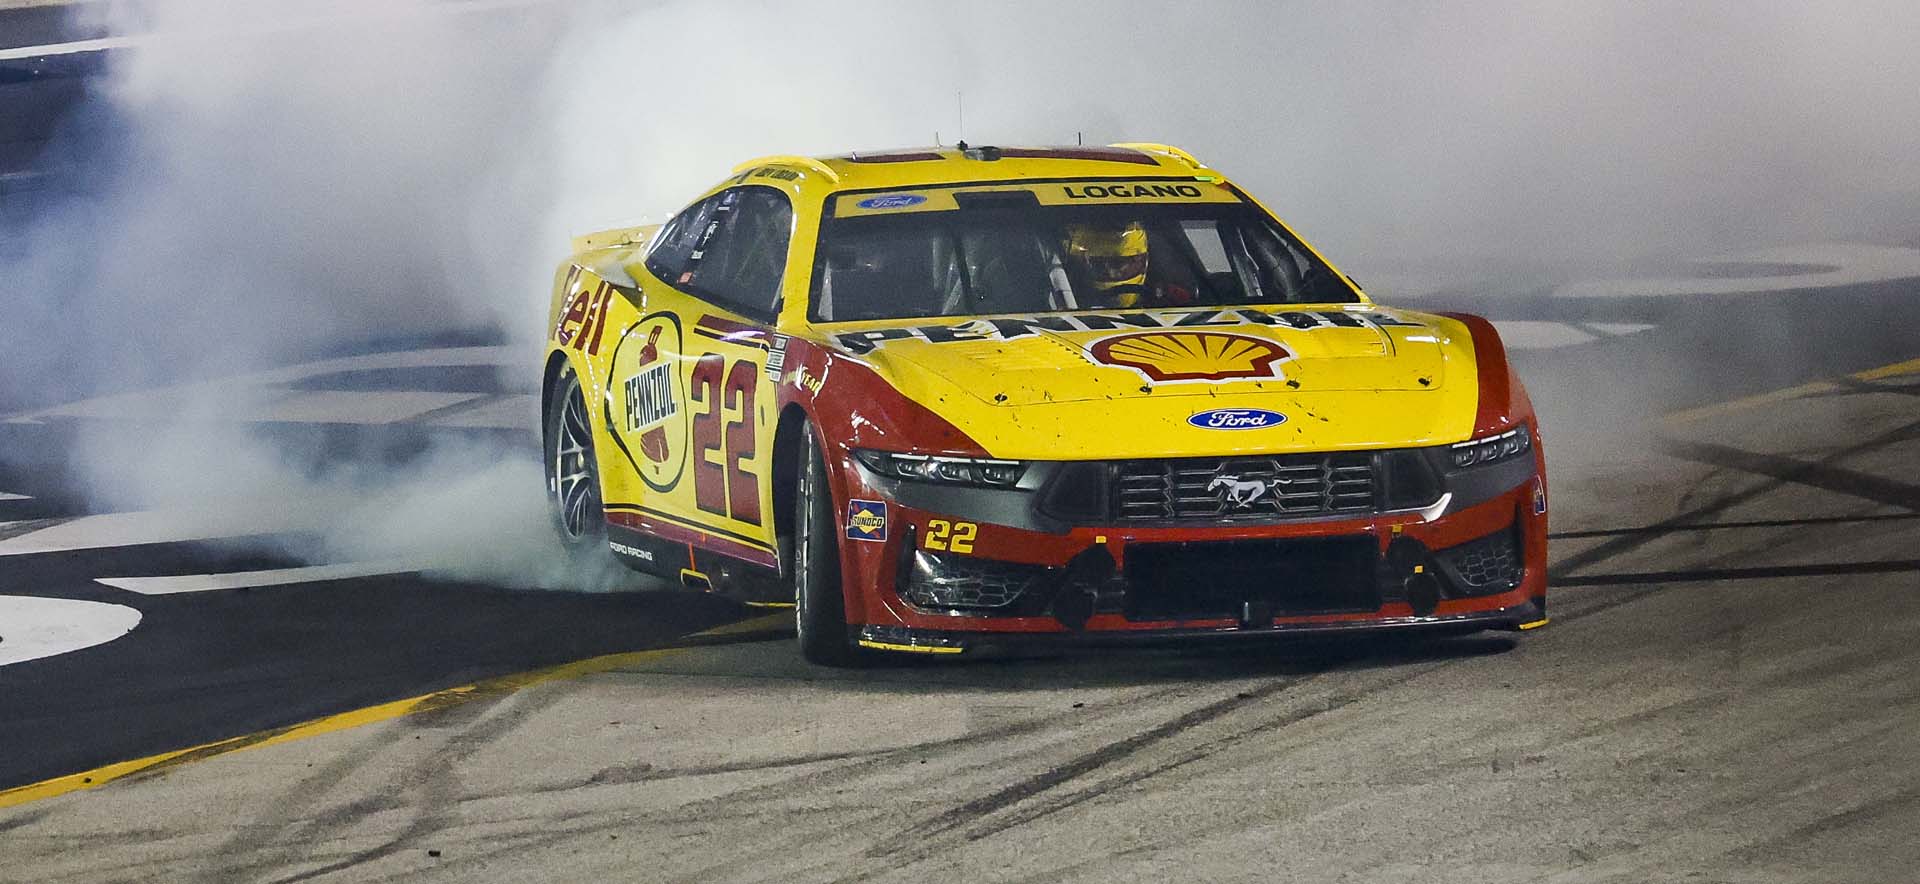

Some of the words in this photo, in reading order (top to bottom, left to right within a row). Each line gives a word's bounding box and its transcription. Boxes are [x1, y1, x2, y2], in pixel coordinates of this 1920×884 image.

[1063, 185, 1202, 199] LOGANO
[871, 196, 913, 209] Ford
[624, 362, 676, 432] PENNZOIL
[1207, 411, 1268, 427] Ford
[691, 352, 762, 527] 22
[851, 516, 885, 528] SUNOCO
[925, 519, 979, 554] 22
